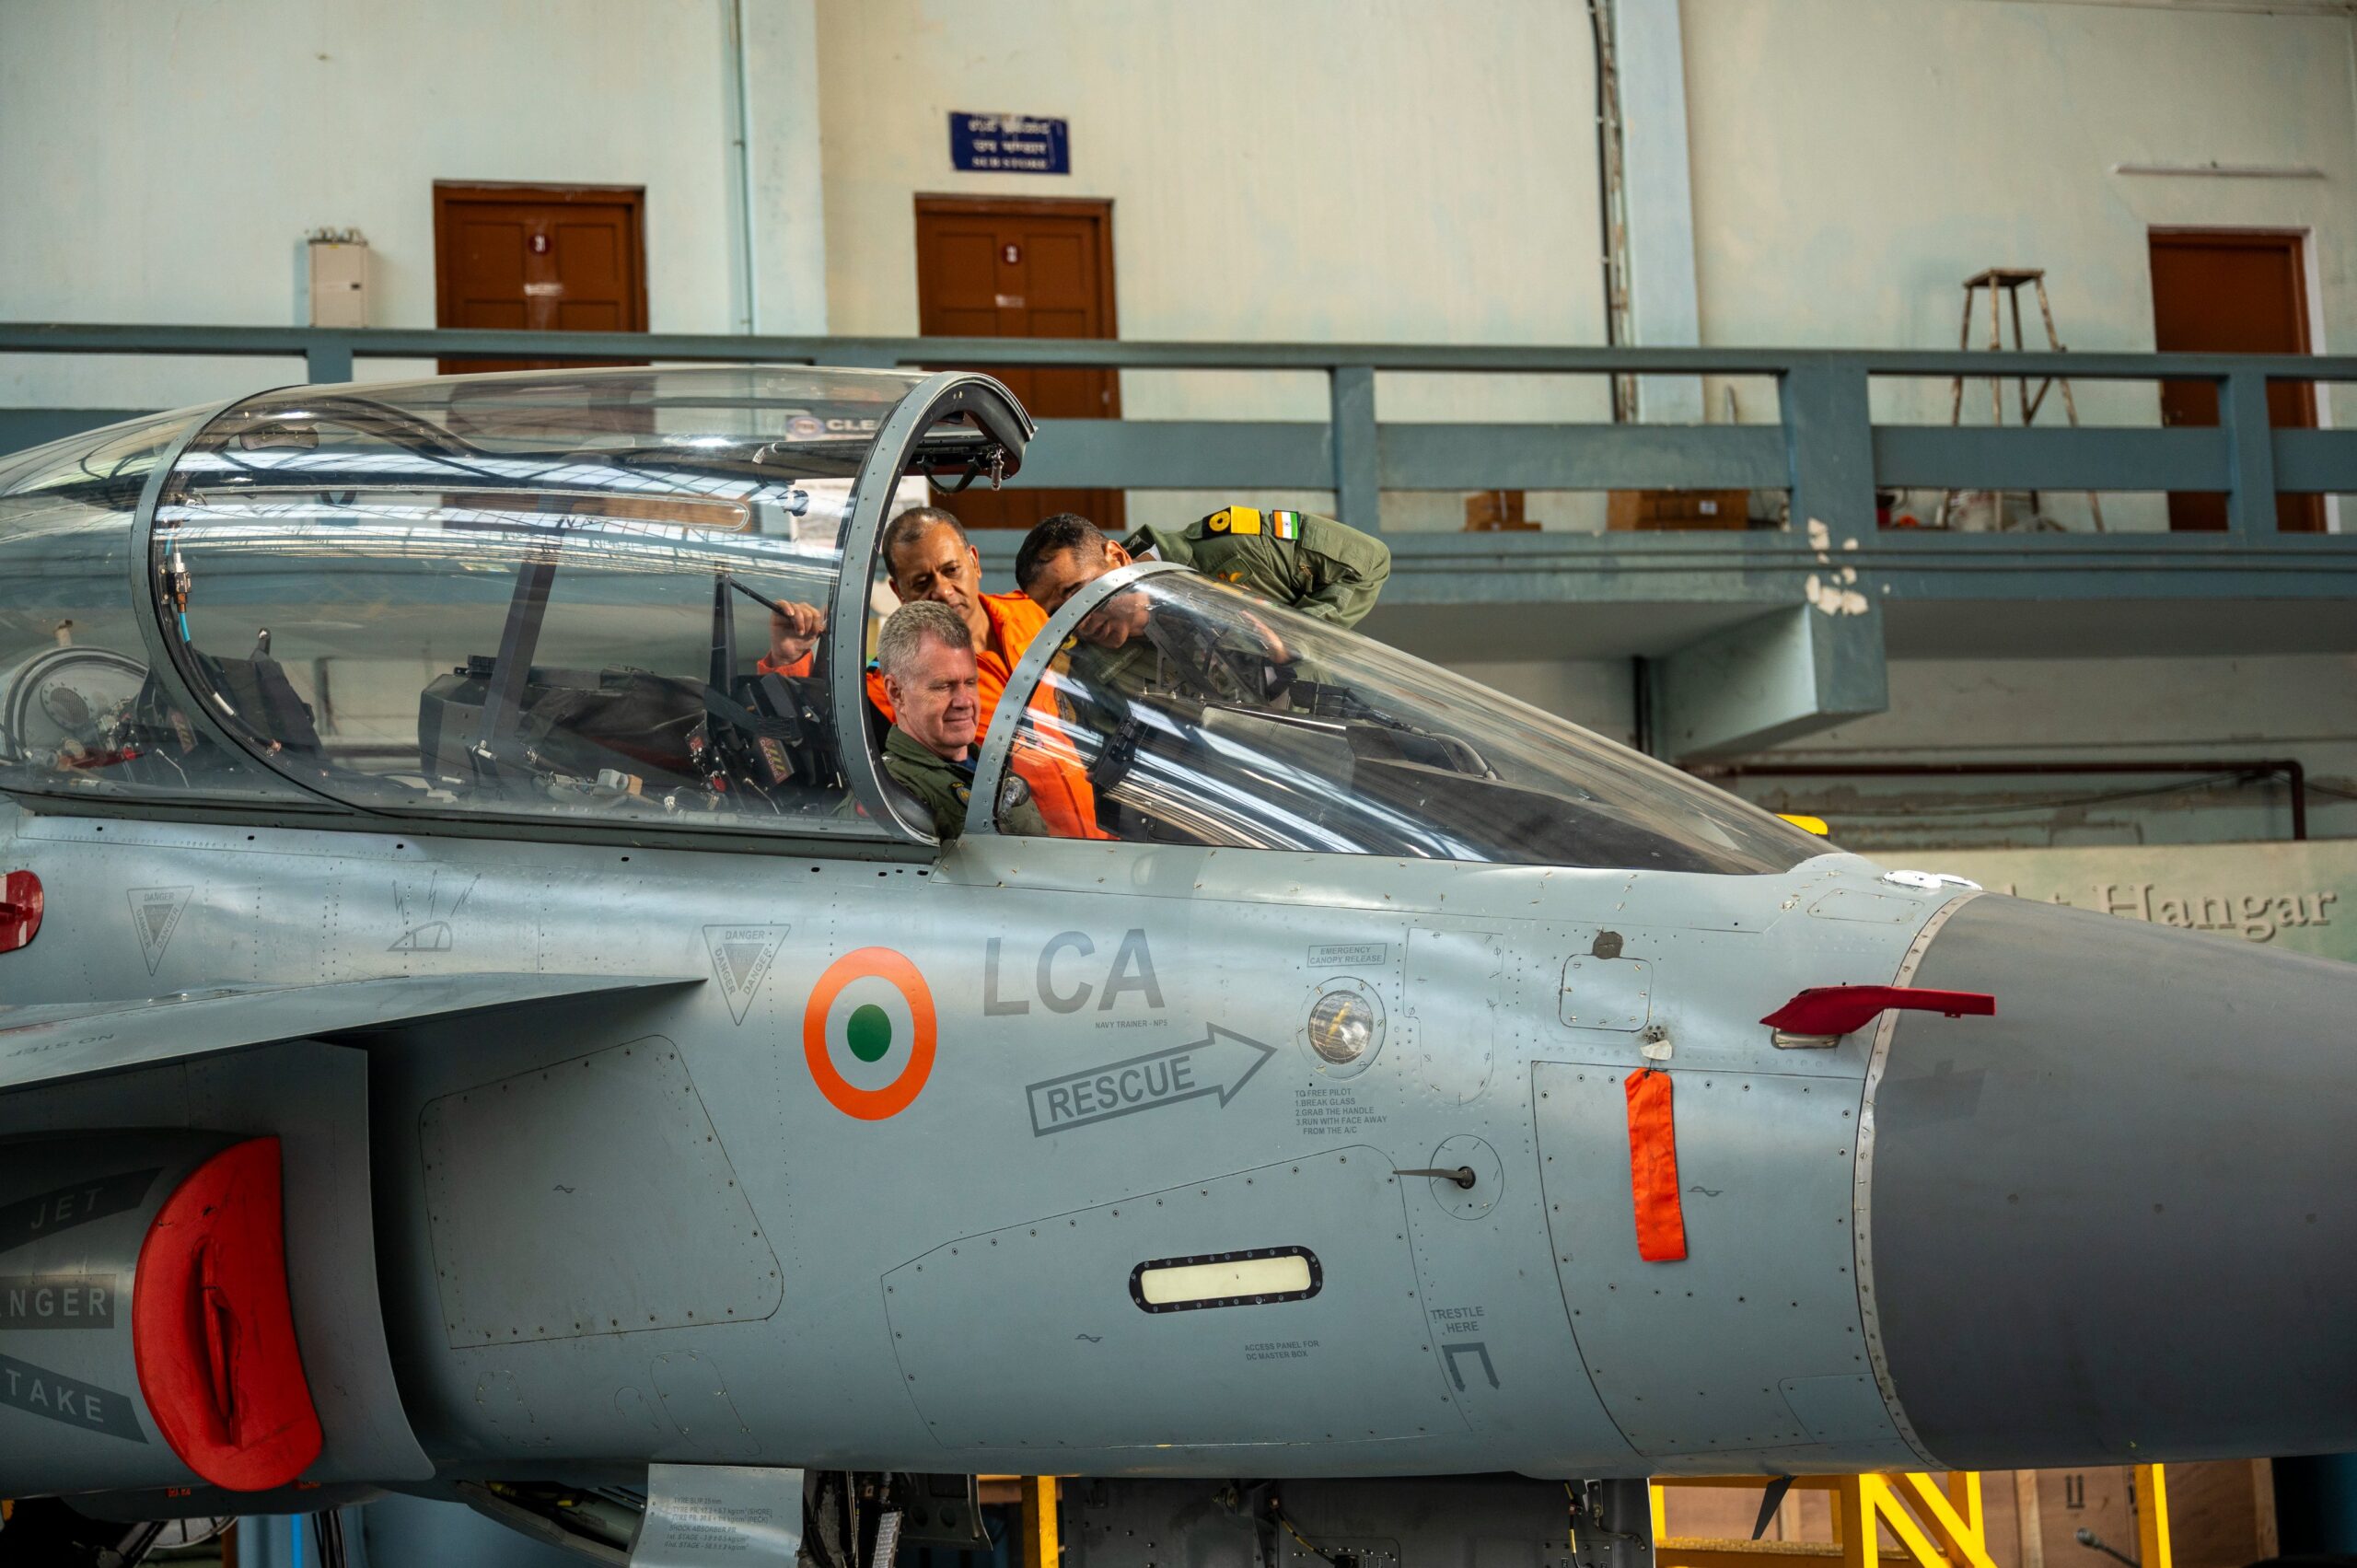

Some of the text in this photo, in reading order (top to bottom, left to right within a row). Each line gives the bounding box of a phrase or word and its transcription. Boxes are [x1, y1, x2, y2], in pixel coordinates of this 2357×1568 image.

[144, 892, 175, 901] DANGER
[2092, 883, 2340, 943] Hangar
[156, 906, 180, 949] DANGER
[725, 930, 765, 940] DANGER
[1319, 947, 1371, 955] EMERGENCY
[1309, 955, 1383, 965] CANOPY RELEASE
[714, 947, 736, 994] DANGER
[743, 947, 772, 995] DANGER
[983, 928, 1166, 1016] LCA
[1095, 1021, 1114, 1029] NAVY
[1116, 1019, 1148, 1028] TRAINER
[1047, 1055, 1195, 1121] RESCUE
[1295, 1089, 1306, 1098] TO
[1329, 1088, 1352, 1097] PILOT
[1329, 1098, 1356, 1106] GLASS
[1326, 1108, 1341, 1116] THE
[1319, 1117, 1340, 1125] WITH
[1341, 1116, 1362, 1124] FACE
[1364, 1115, 1387, 1123] AWAY
[1303, 1127, 1326, 1135] FROM
[1343, 1126, 1357, 1134] A/C
[30, 1187, 103, 1230] JET
[0, 1287, 107, 1318] NGER
[1430, 1307, 1486, 1319] TRESTLE
[1446, 1321, 1480, 1333] HERE
[1245, 1340, 1320, 1352] ACCESS PANEL FOR
